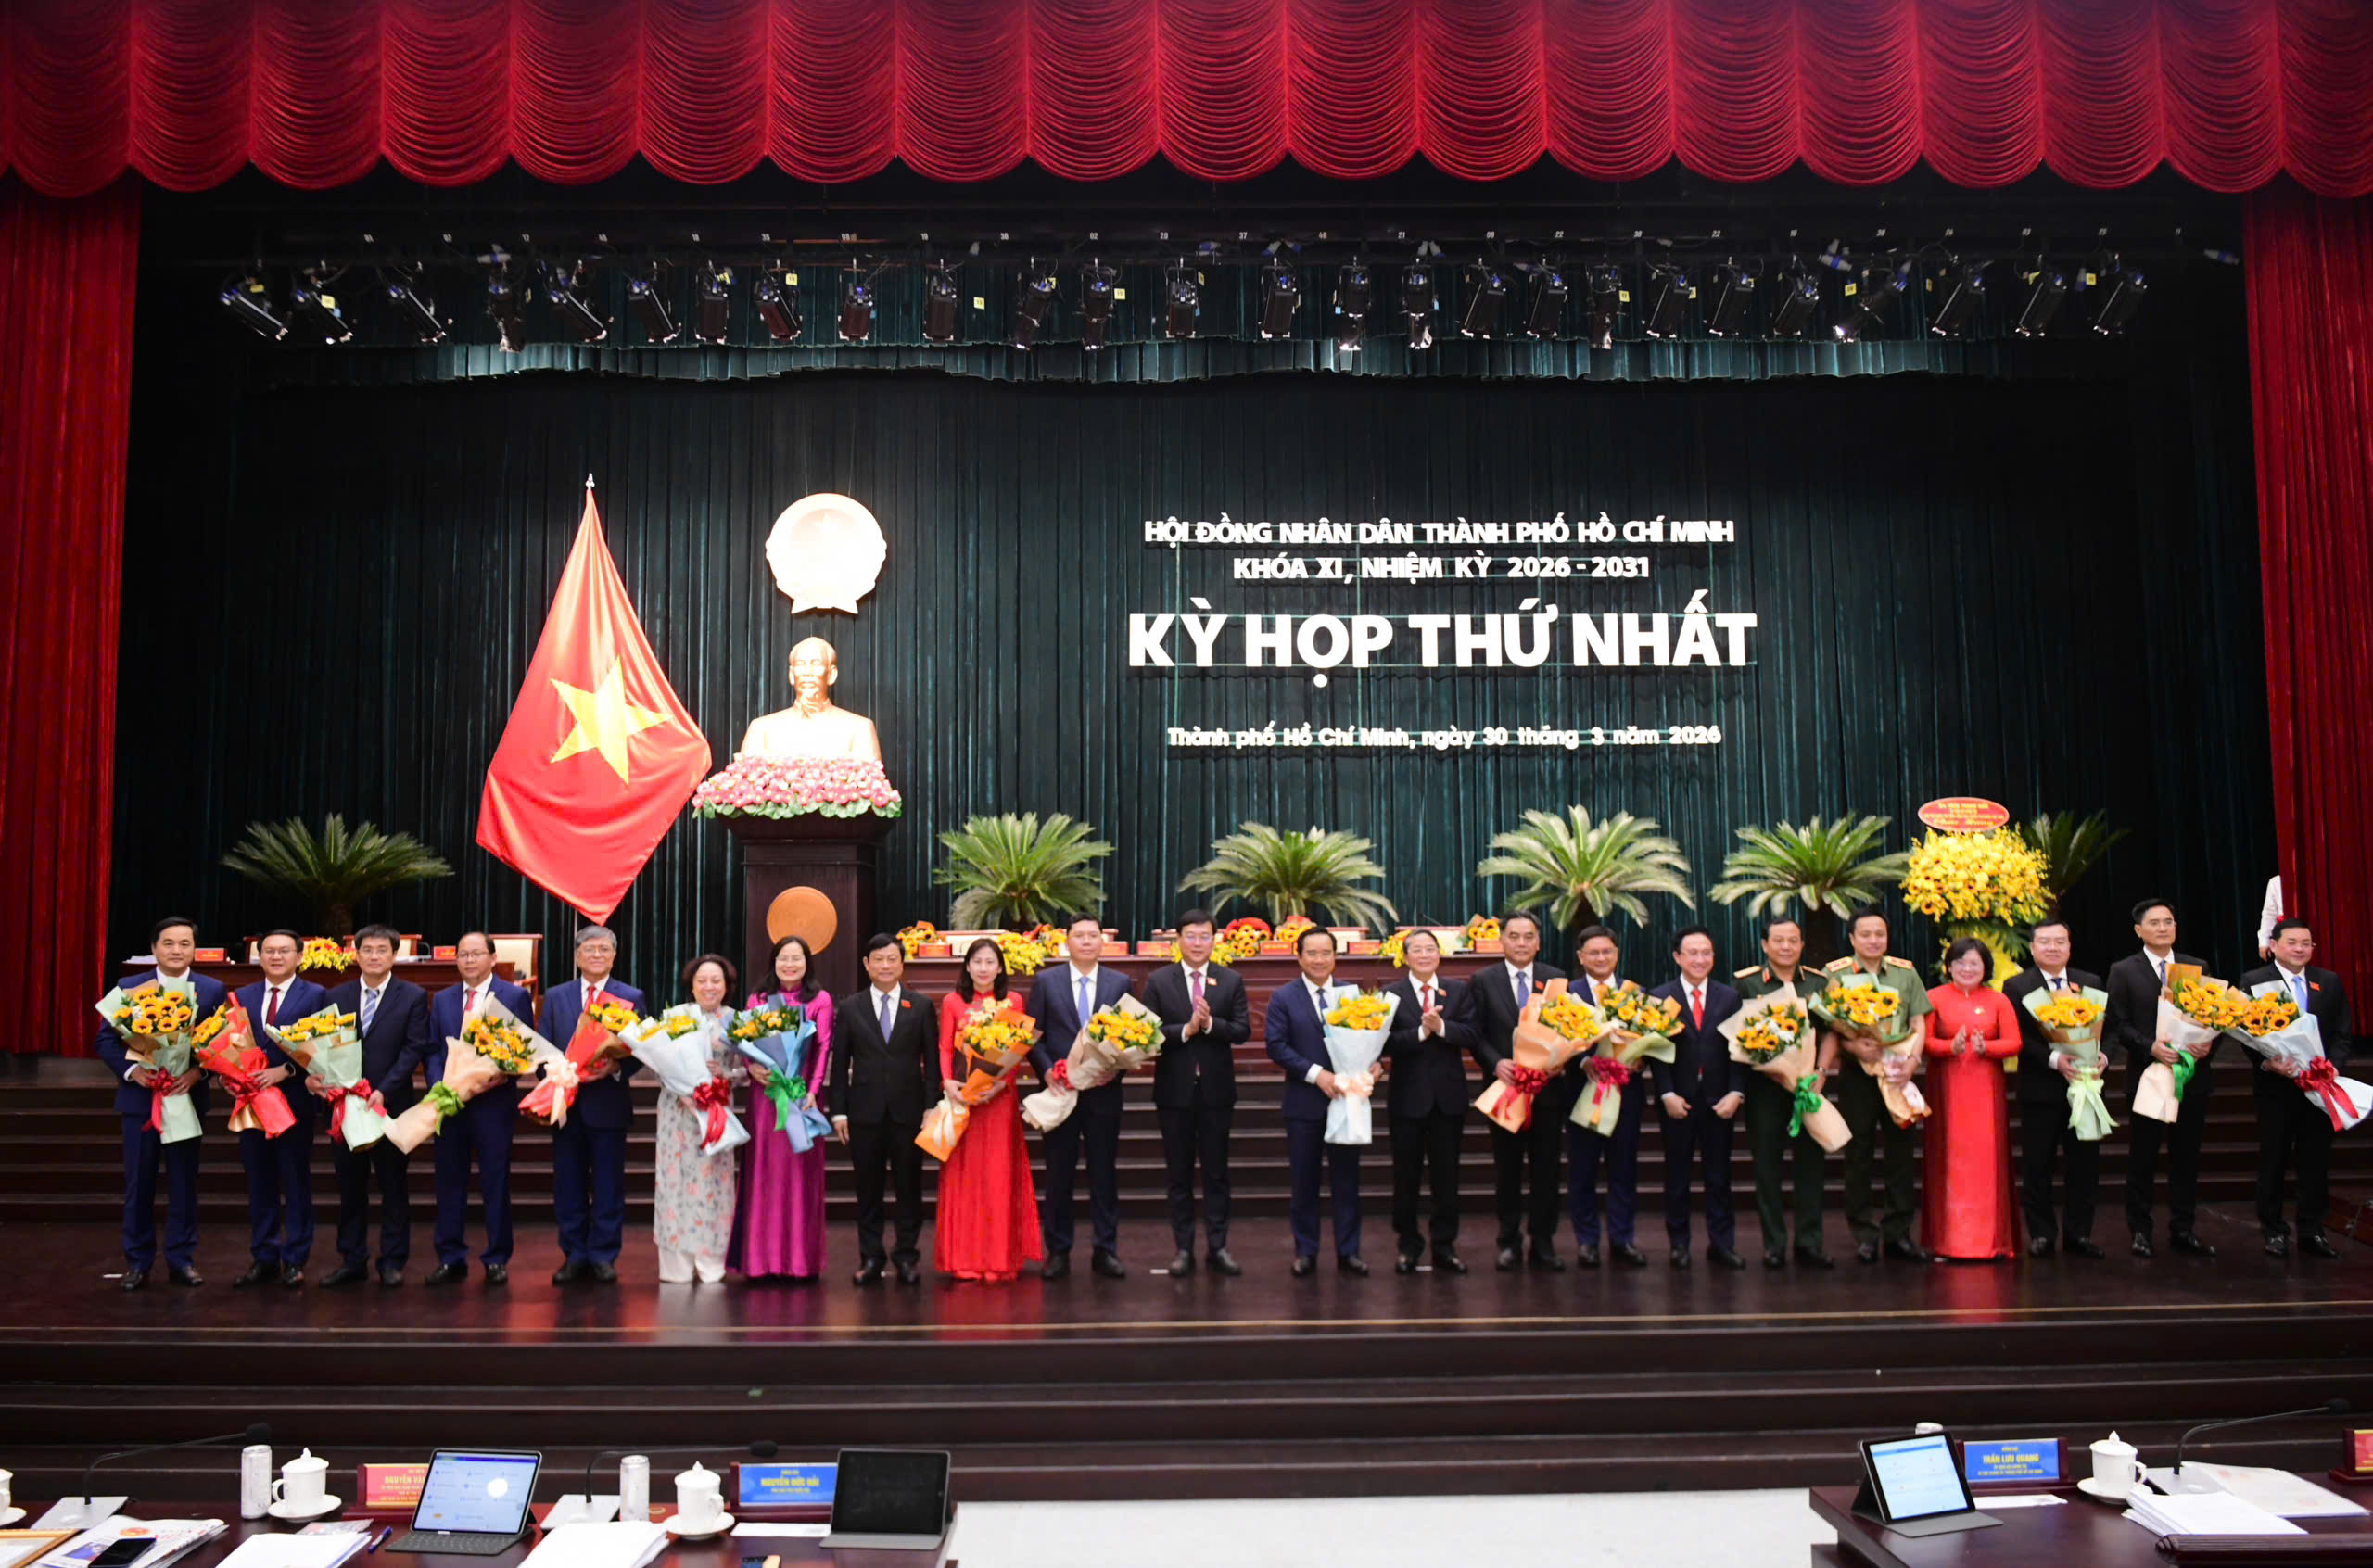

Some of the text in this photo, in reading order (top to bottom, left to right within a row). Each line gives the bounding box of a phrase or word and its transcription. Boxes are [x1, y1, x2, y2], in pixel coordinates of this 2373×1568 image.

[1160, 232, 1169, 241] 20
[1239, 232, 1248, 240] 37
[1398, 231, 1405, 240] 21
[1555, 230, 1565, 238] 22
[1144, 512, 1735, 549] HỘI ĐỒNG NHÂN DÂN THÀNH PHỐ HỒ CHÍ MINH
[1233, 551, 1309, 579] KHÓA
[1314, 557, 1354, 585] XI,
[1361, 551, 1444, 585] NHIỆM
[1454, 550, 1492, 578] KỲ
[1506, 556, 1572, 578] 2026
[1591, 556, 1649, 578] 2031
[1128, 588, 1758, 689] KỲ HỌP THỨ NHẤT
[1167, 720, 1722, 751] Thành phố Hồ Chí Minh, ngày 30 tháng 3 năm 2026
